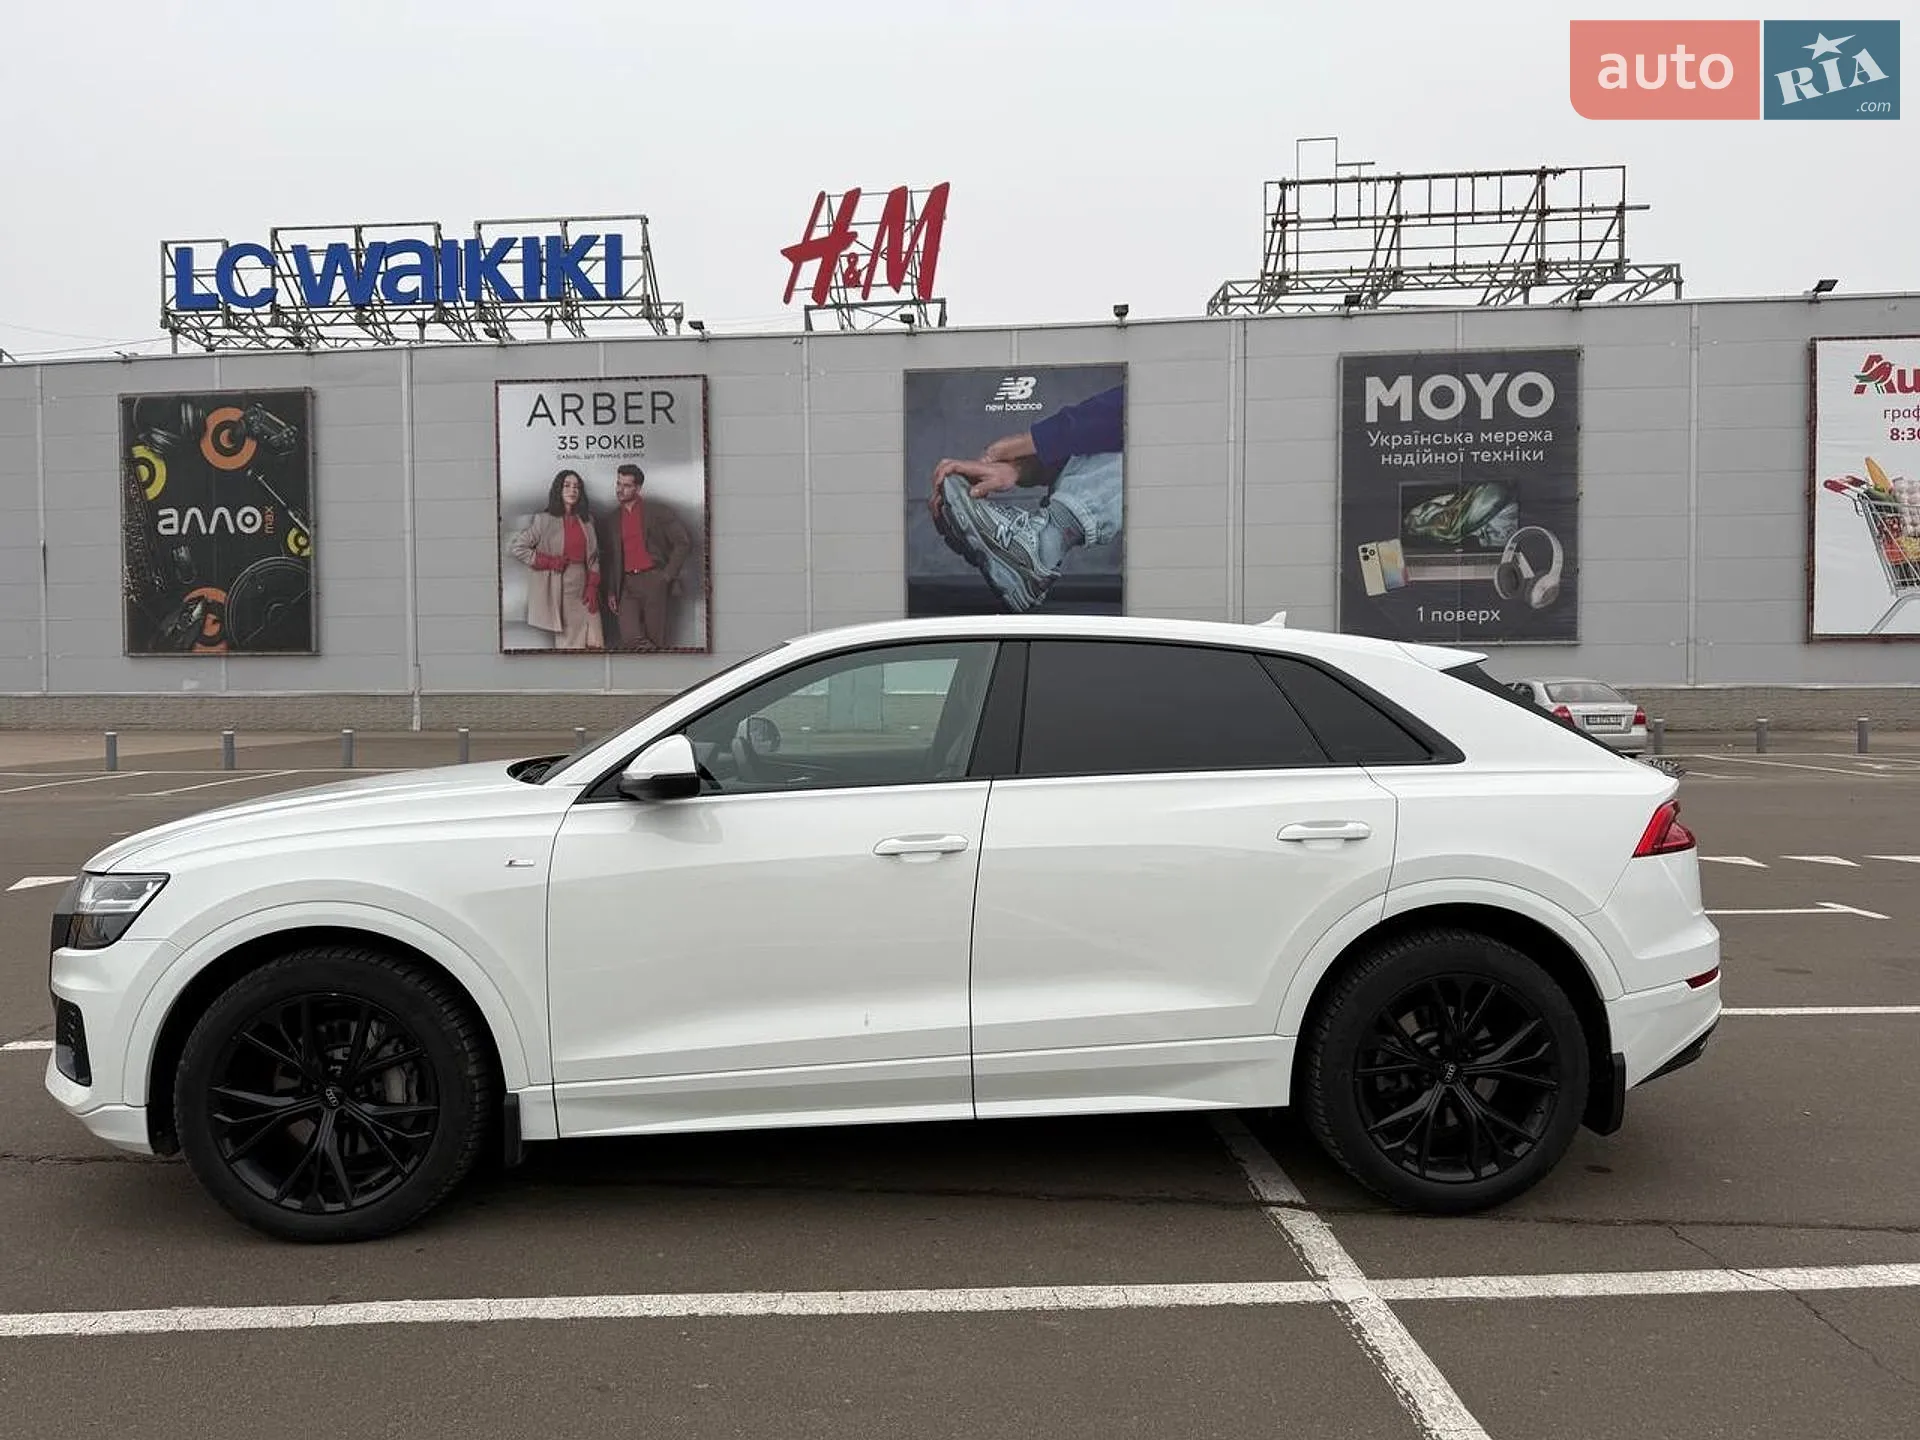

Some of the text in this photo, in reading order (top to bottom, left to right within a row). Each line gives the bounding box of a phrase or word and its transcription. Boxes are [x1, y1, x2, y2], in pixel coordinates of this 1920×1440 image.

[780, 181, 950, 308] H&M
[174, 242, 279, 311] LC
[526, 390, 675, 427] ARBER
[1365, 371, 1555, 423] MOYO
[558, 434, 645, 450] 35 РОКІВ
[1367, 430, 1553, 449] Українська мережа
[1381, 446, 1544, 466] надійної техніки
[1417, 606, 1500, 624] 1 поверх
